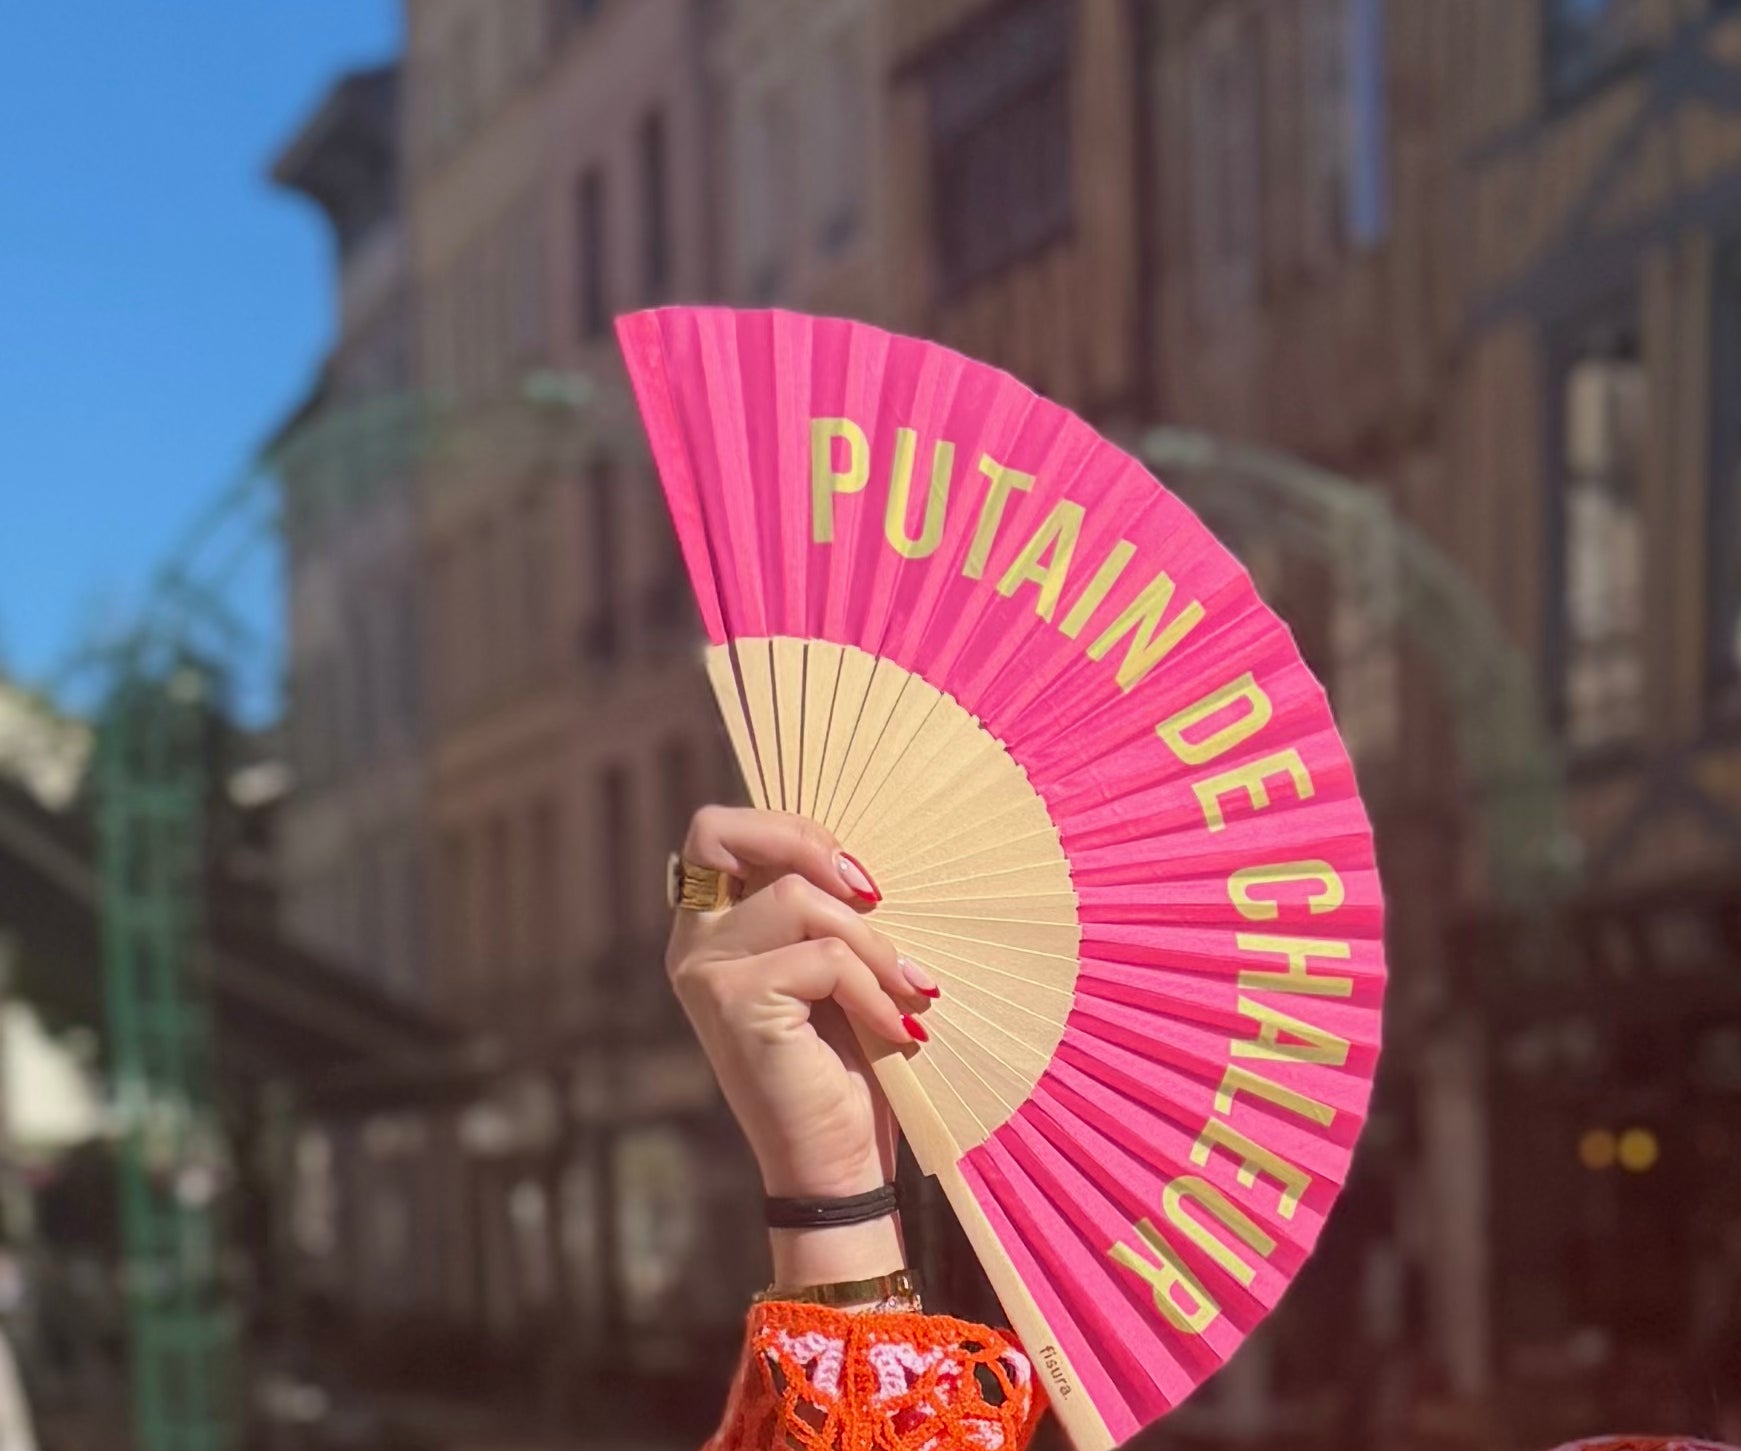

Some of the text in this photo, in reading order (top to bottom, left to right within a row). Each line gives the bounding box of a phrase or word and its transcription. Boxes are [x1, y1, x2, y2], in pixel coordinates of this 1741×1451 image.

[810, 416, 1354, 1333] PUTAIN DE CHALEUR
